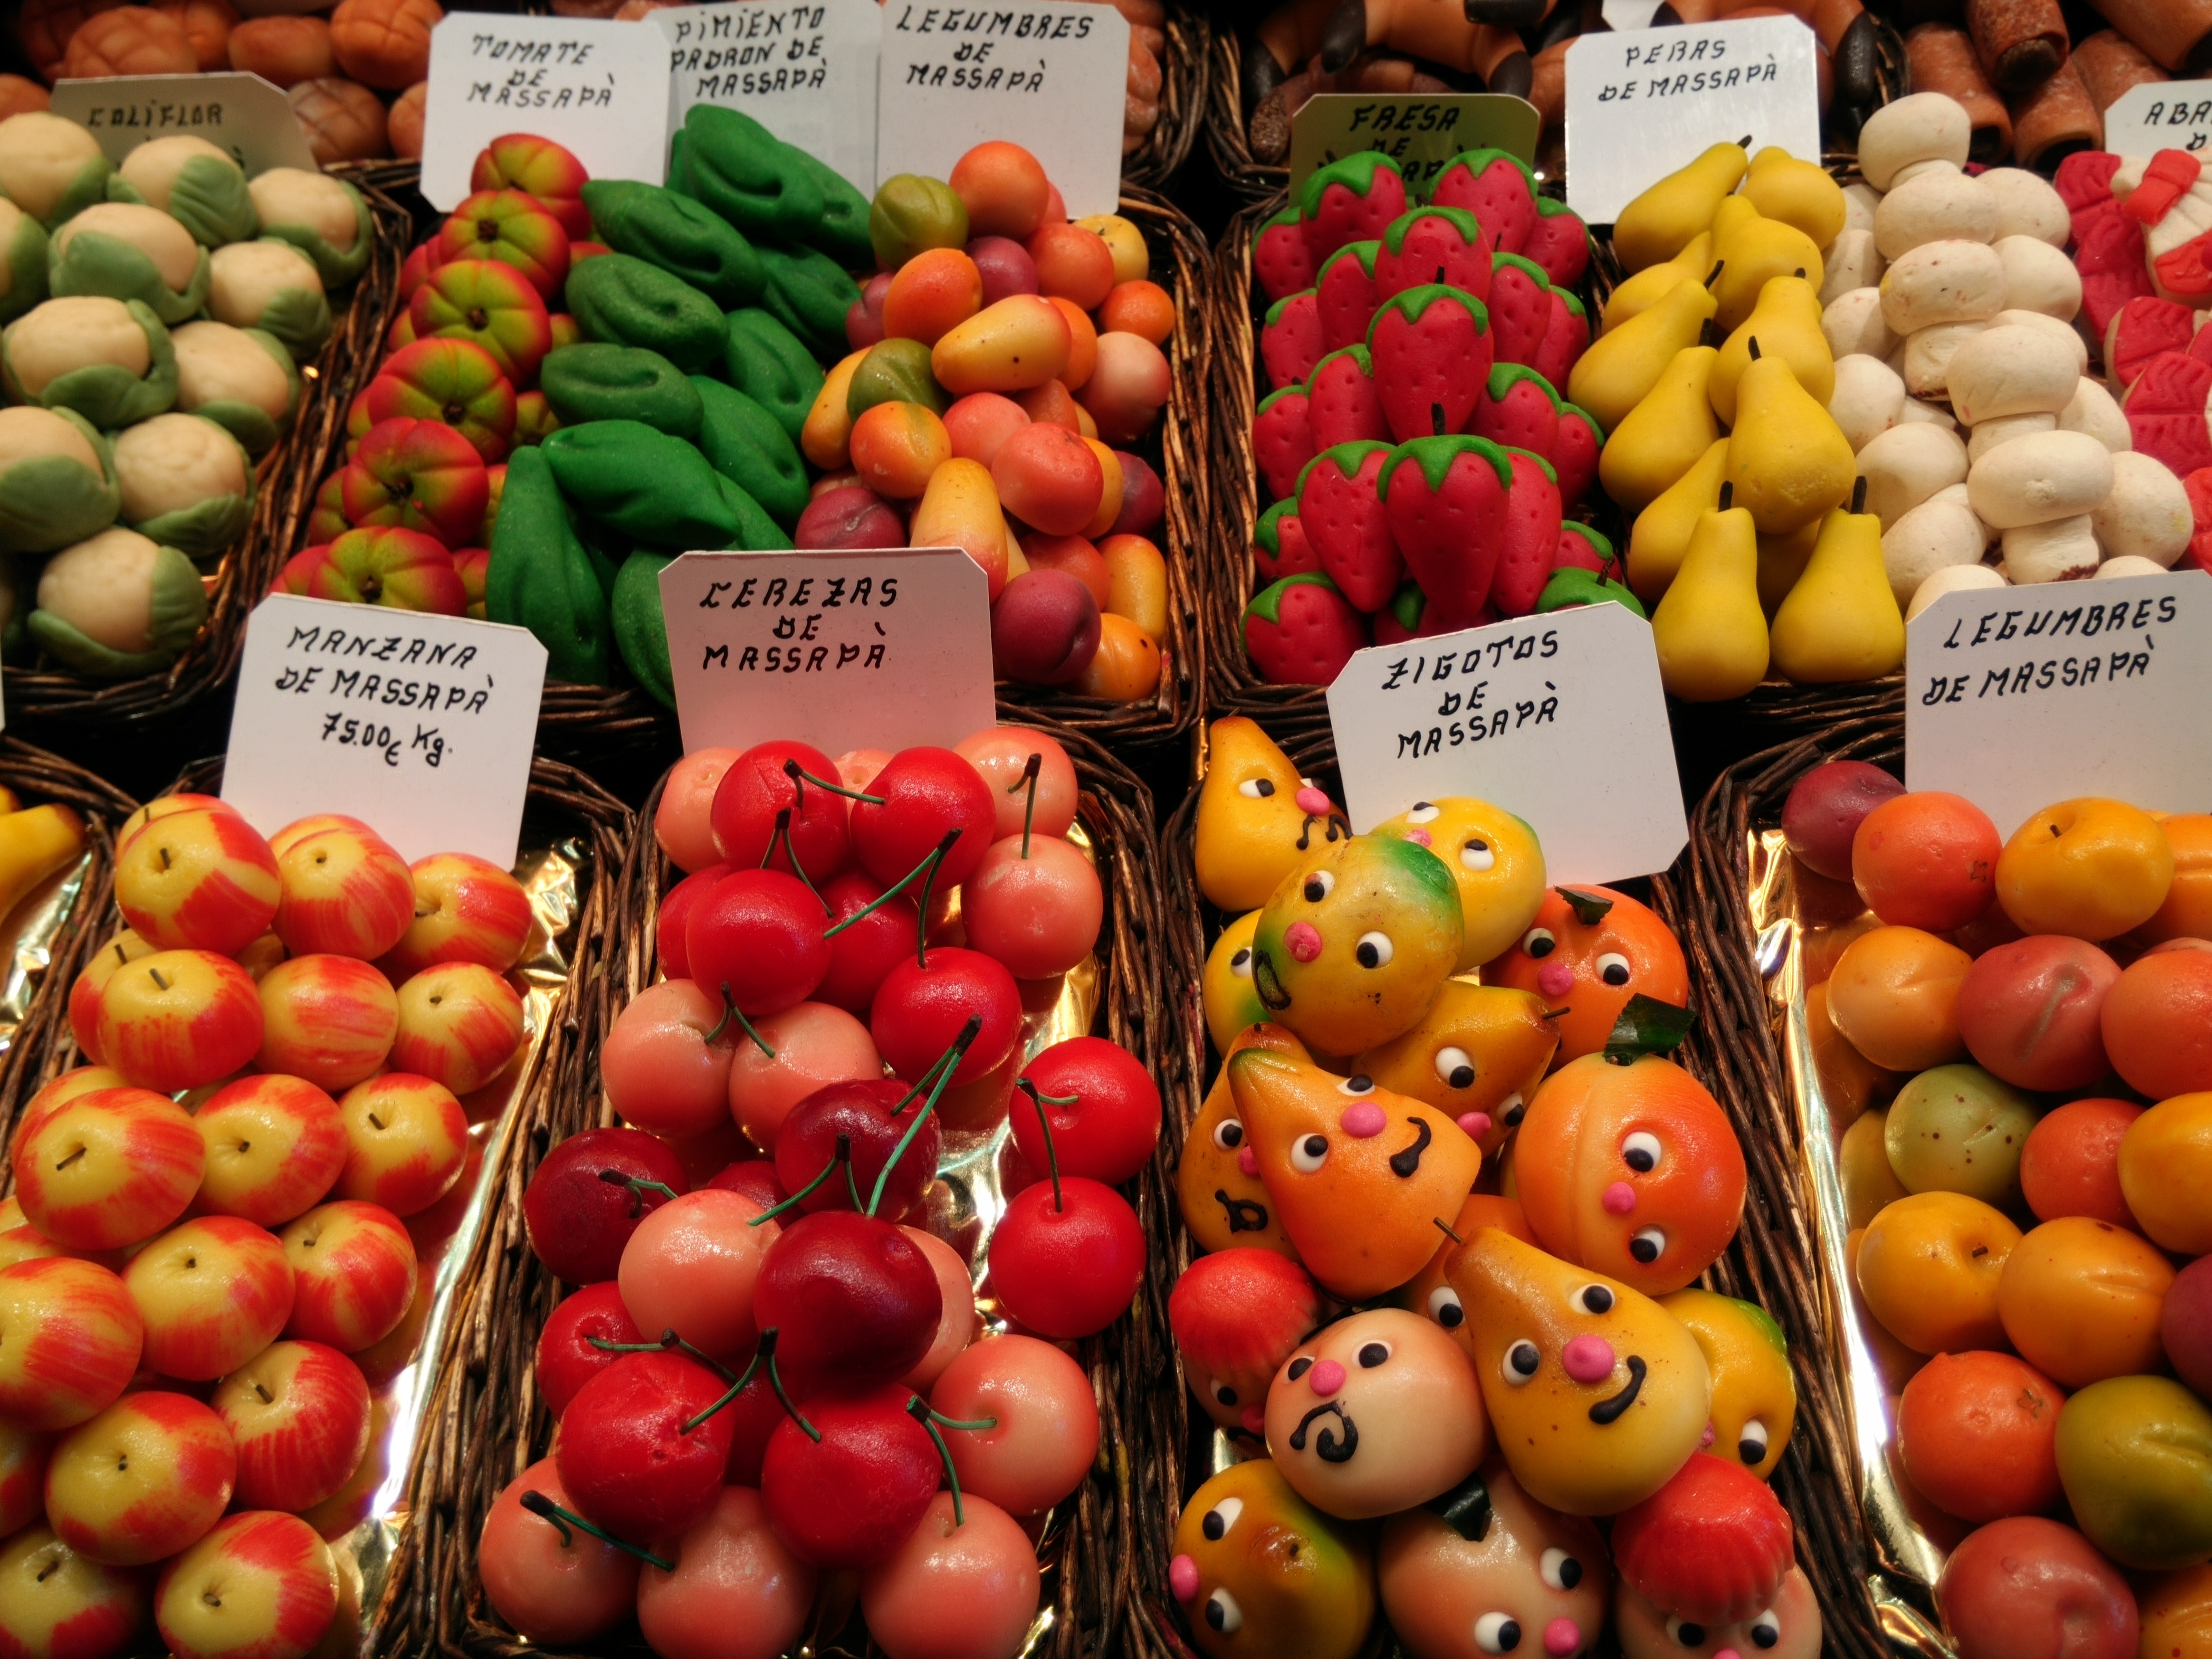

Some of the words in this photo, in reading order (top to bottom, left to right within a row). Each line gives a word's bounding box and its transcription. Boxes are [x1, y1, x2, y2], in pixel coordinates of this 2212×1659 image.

[676, 6, 826, 43] PIMIENTO
[896, 5, 1094, 39] LEGUMBRES
[473, 34, 594, 65] TOMATE
[670, 43, 776, 72] PADRON
[787, 36, 825, 60] DE
[953, 42, 994, 63] DE
[1626, 39, 1725, 67] PERAS
[468, 73, 614, 108] MASSAPÀ
[507, 69, 547, 87] DE
[696, 58, 827, 98] MASSAPÀ
[906, 59, 1046, 92] MASSAPÀ
[1598, 81, 1637, 102] DE
[1647, 54, 1777, 97] MASSAPÀ
[1349, 104, 1460, 132] FRESA
[2144, 100, 2212, 125] ABA
[699, 577, 898, 609] CEREZAS
[772, 614, 822, 641] DE
[1943, 596, 2177, 649] LEGUMBRES
[287, 626, 477, 669] MANZANA
[703, 622, 886, 673] MASSAPÀ
[1381, 630, 1559, 689] ZIGOTOS
[1922, 675, 1970, 706] DE
[1978, 634, 2154, 698] MASSAPÀ
[275, 667, 323, 693] DE
[330, 675, 494, 714] MASSAPÀ
[1438, 681, 1488, 716] DE
[1397, 681, 1559, 759] MASSAPÀ
